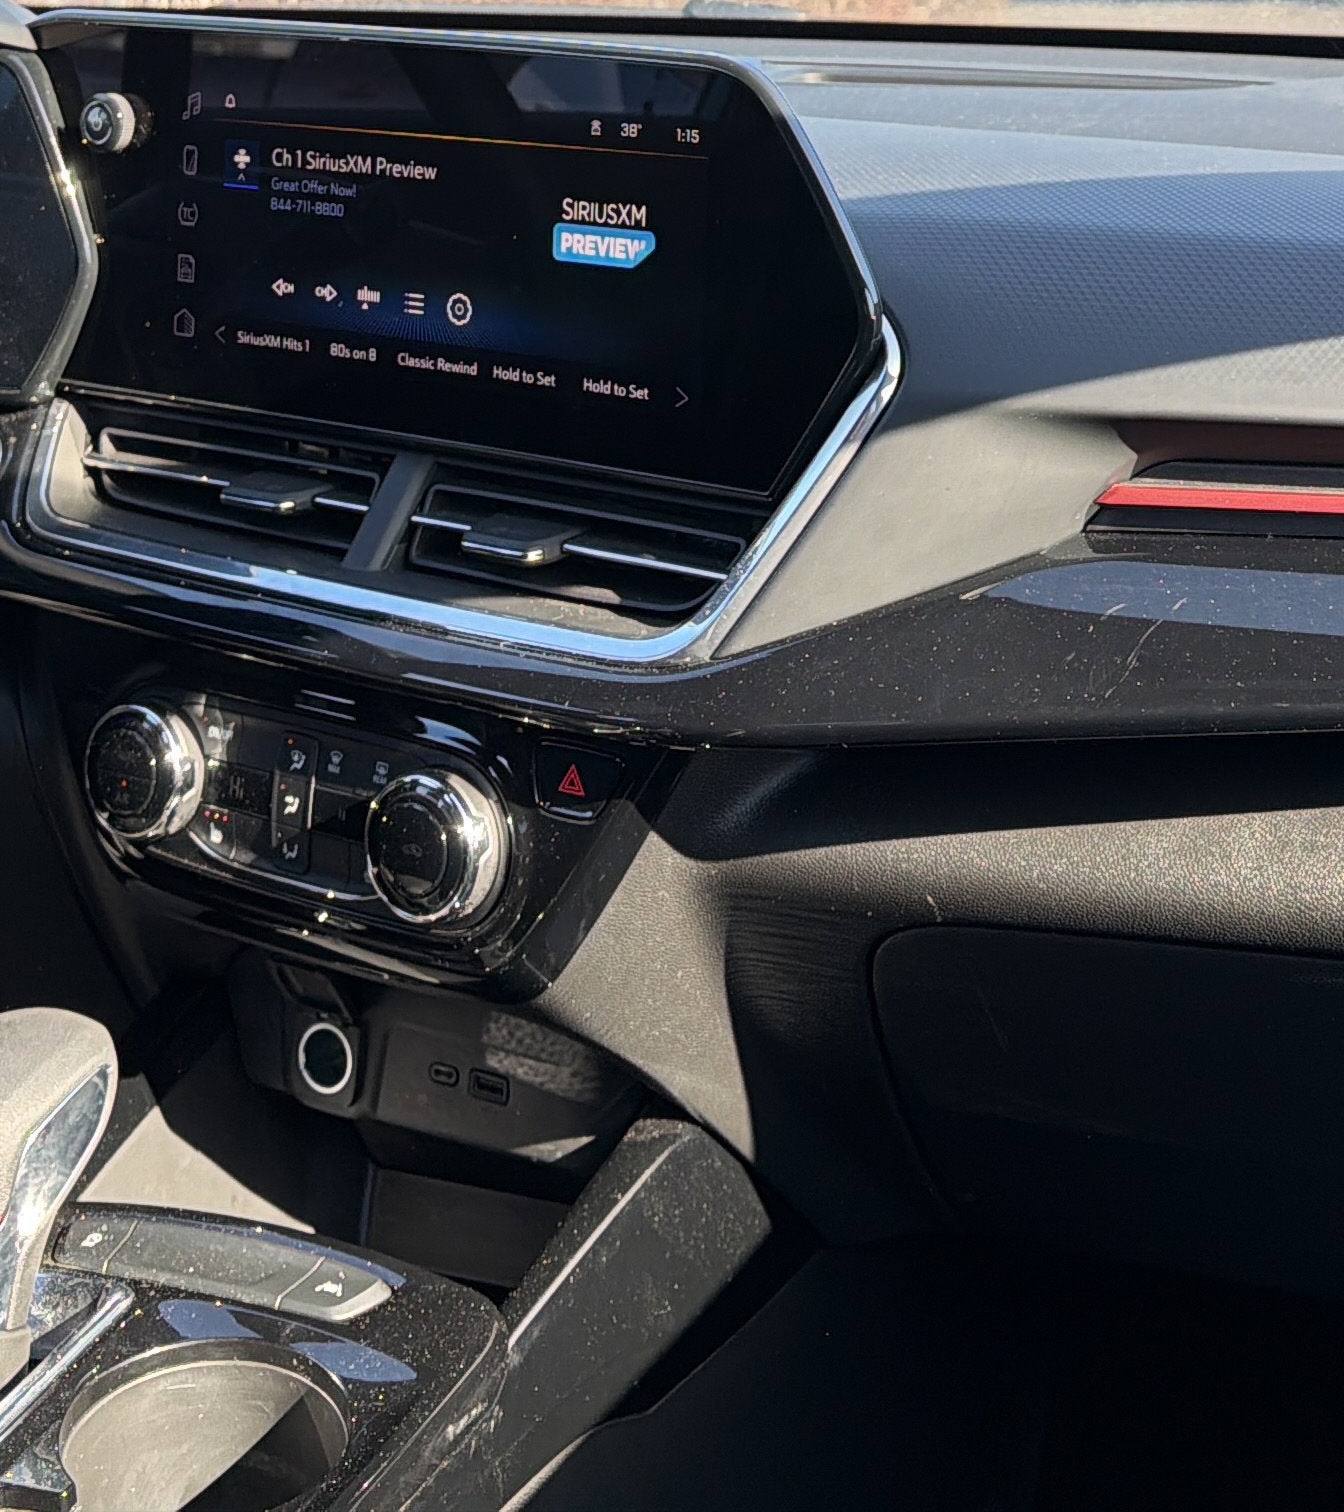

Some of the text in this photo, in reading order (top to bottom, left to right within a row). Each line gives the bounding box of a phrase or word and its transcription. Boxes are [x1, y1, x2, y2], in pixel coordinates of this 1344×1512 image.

[621, 123, 642, 137] 38°
[676, 128, 699, 143] 1:15
[272, 148, 437, 180] Ch 1 SiriusXM Preview
[272, 177, 356, 197] Great Offer Now!
[270, 197, 344, 217] 844-711-8800
[562, 197, 646, 227] SIRIUSXM
[561, 232, 647, 260] PREVIEW
[237, 330, 310, 352] SiriusXM Hits 1
[330, 343, 377, 362] 80s on 8
[398, 352, 477, 376] Classic Rewind
[492, 365, 556, 387] Hold to Set
[583, 377, 650, 400] Hold to Set
